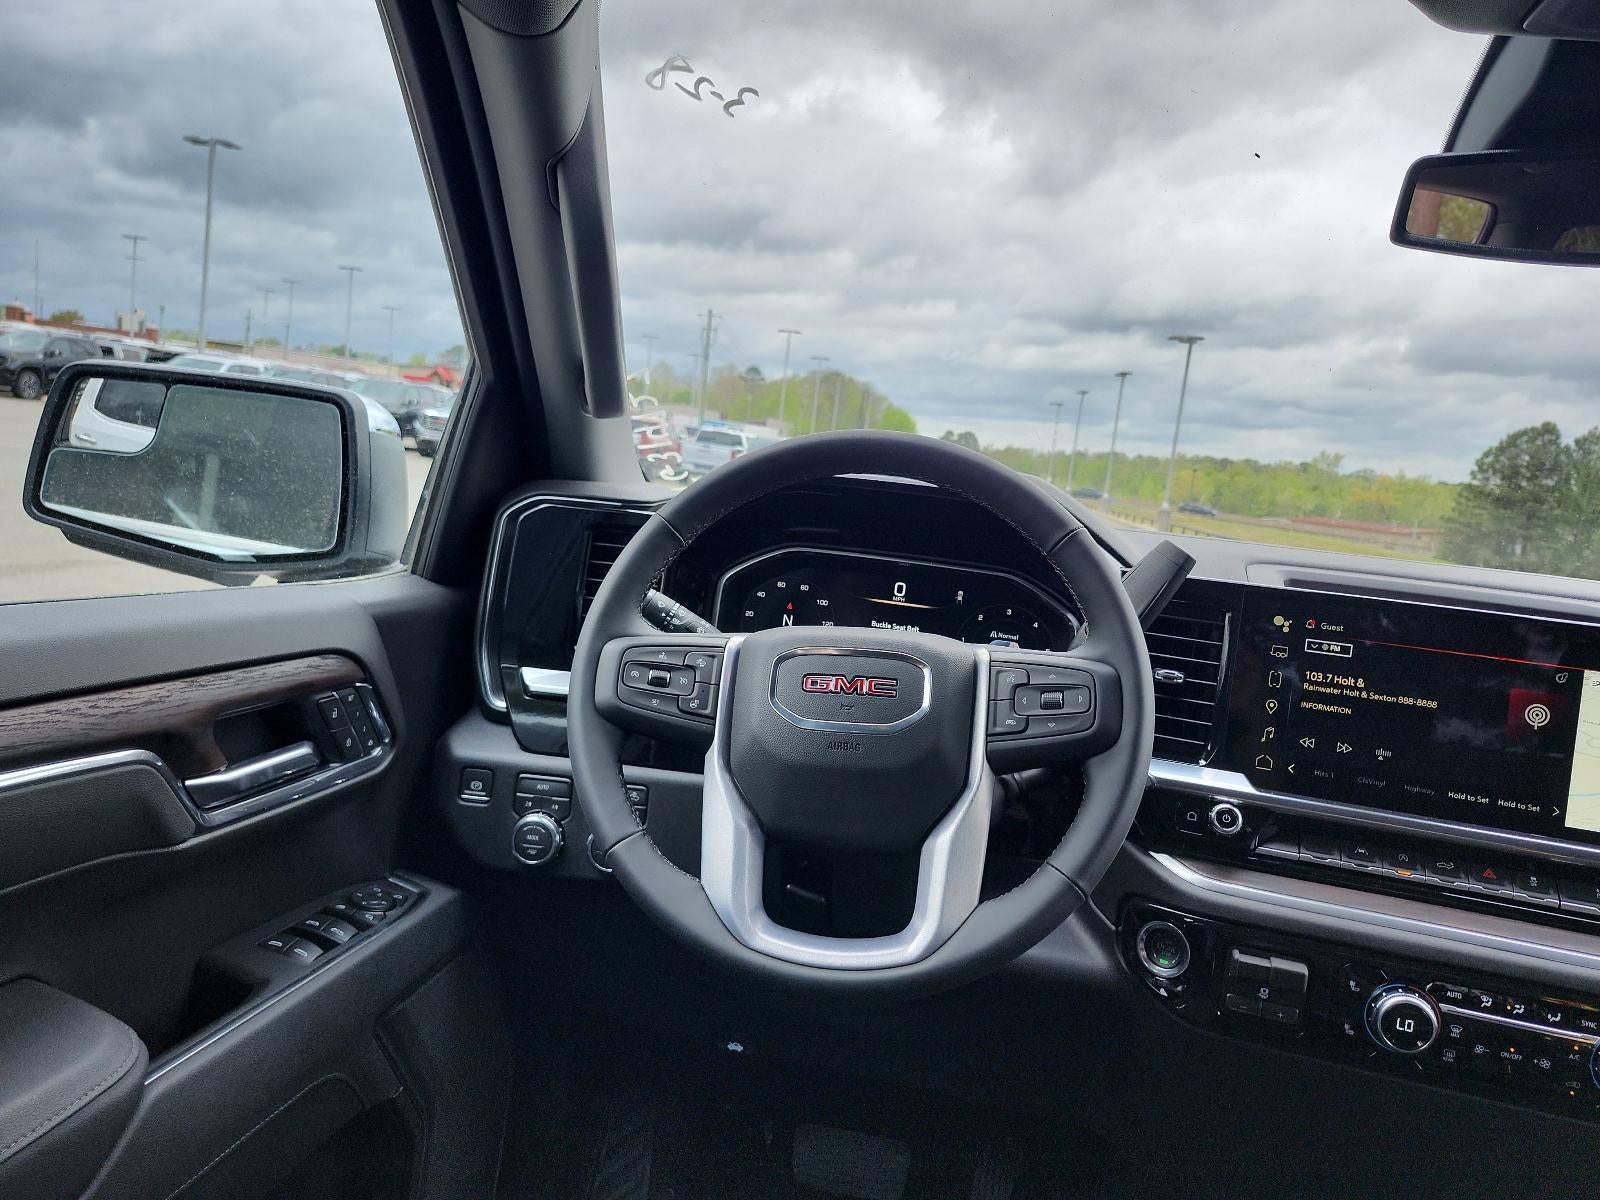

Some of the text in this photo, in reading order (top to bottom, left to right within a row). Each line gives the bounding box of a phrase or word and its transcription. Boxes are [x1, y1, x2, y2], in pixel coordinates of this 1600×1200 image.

[894, 582, 907, 597] 0
[1006, 608, 1012, 616] 3
[782, 614, 794, 627] N
[871, 621, 892, 629] Buckle
[1321, 622, 1344, 632] Guest
[998, 632, 1019, 641] Normal
[1330, 644, 1341, 652] FM
[1305, 671, 1365, 688] 103.7 Holt &
[803, 674, 897, 698] GMC
[1303, 682, 1341, 695] Rainwater
[1343, 688, 1360, 698] Holt
[1361, 690, 1368, 699] &
[1369, 692, 1397, 703] Sexton
[1300, 701, 1352, 715] INFORMATION
[828, 741, 861, 752] AIRBAG
[1314, 769, 1329, 778] Hits
[1404, 784, 1435, 797] Highway
[1448, 791, 1489, 804] Hold to Set
[1498, 799, 1516, 808] Hold
[1527, 804, 1540, 812] Set
[1446, 991, 1463, 1000] AUTO
[1581, 1019, 1598, 1030] SYNC
[1500, 1051, 1523, 1060] ON/OFF
